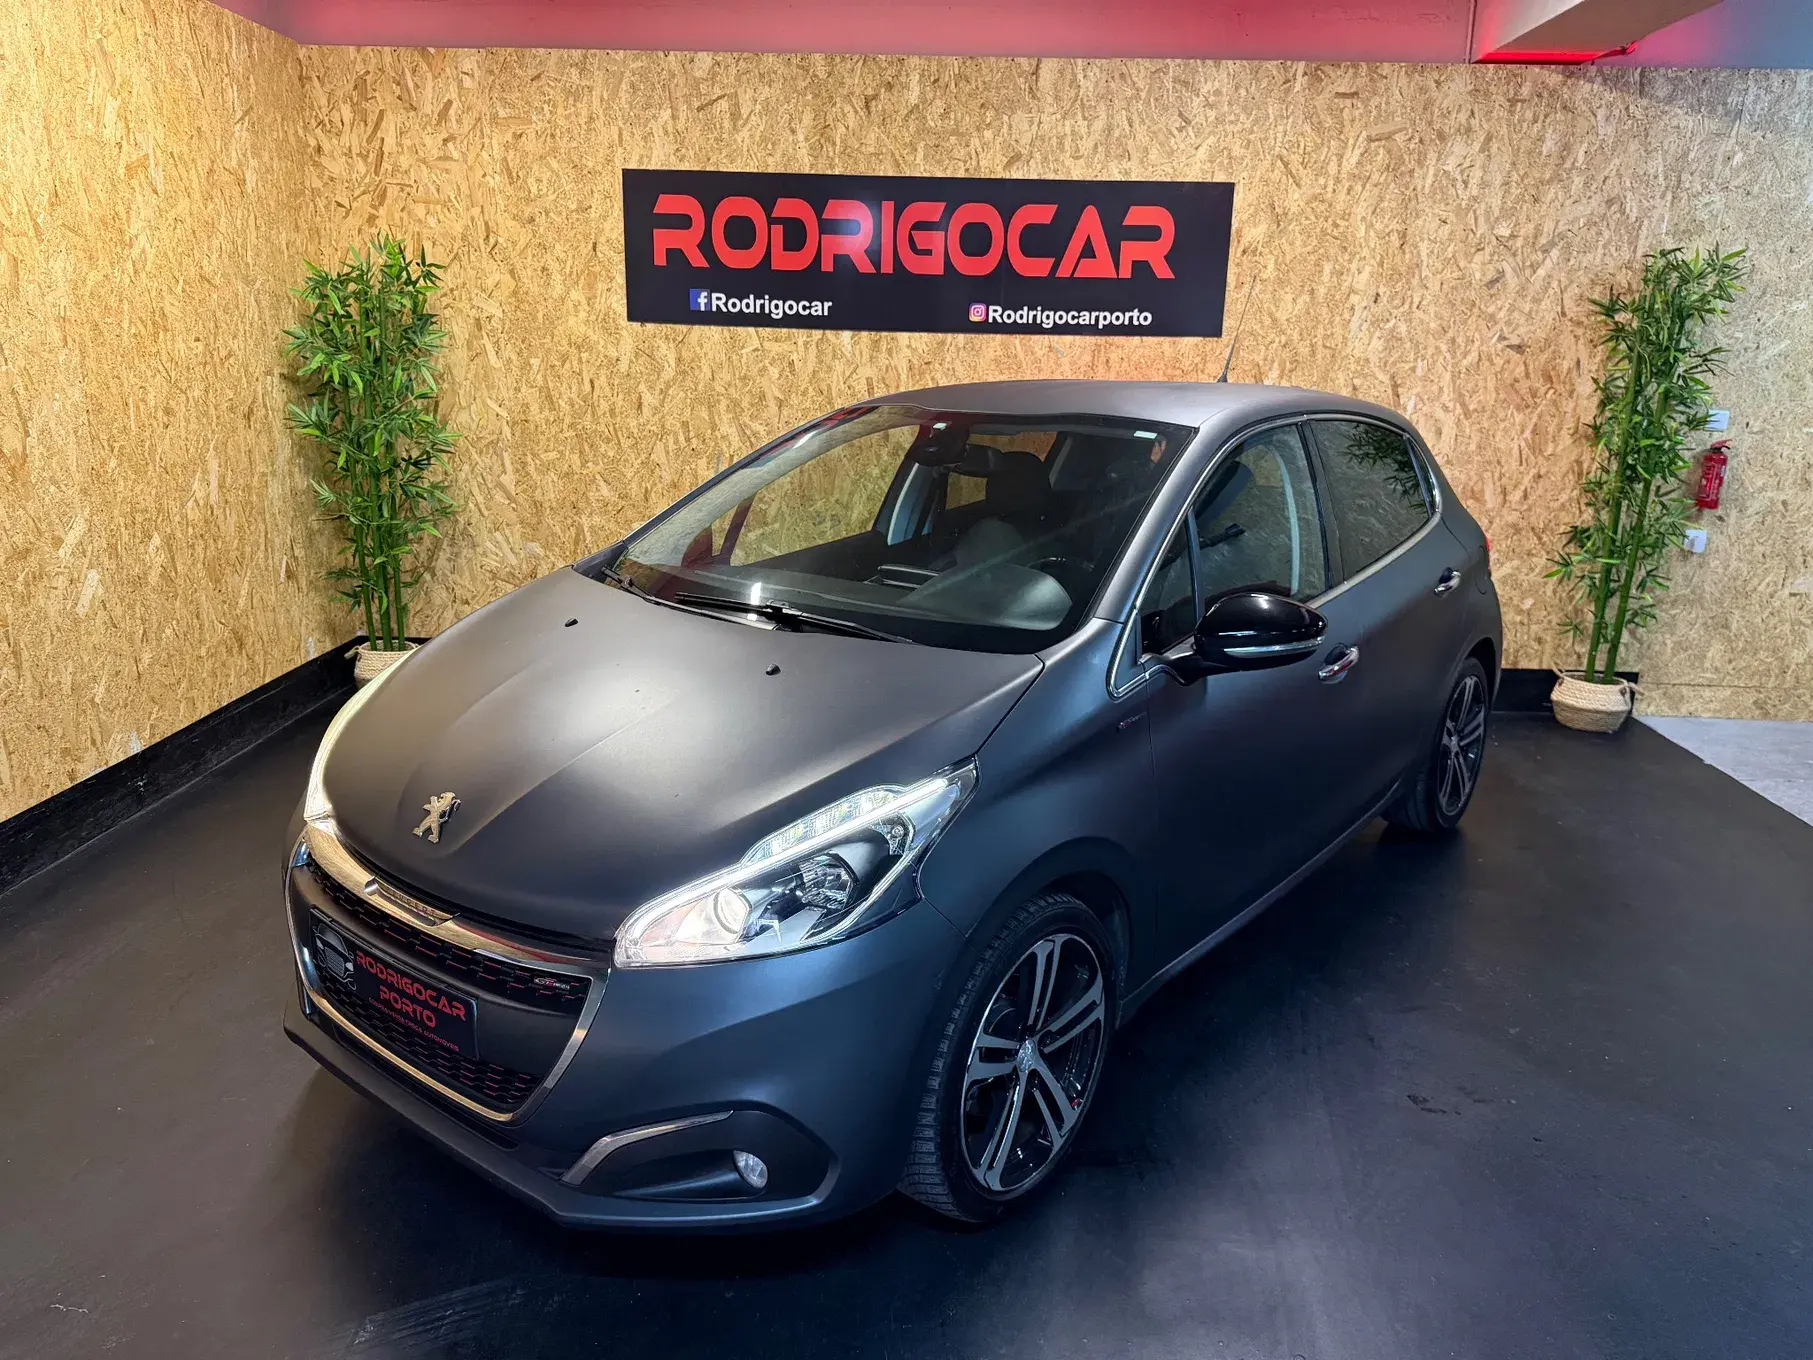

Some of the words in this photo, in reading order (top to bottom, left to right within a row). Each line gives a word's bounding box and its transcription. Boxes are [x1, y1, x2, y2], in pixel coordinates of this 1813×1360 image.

[653, 194, 1175, 279] RODRIGOCAR
[711, 292, 833, 319] Rodrigocar
[988, 305, 1153, 329] Rodrigocarporto
[356, 950, 466, 1022] RODRIGOCAR
[379, 984, 437, 1028] PORTO
